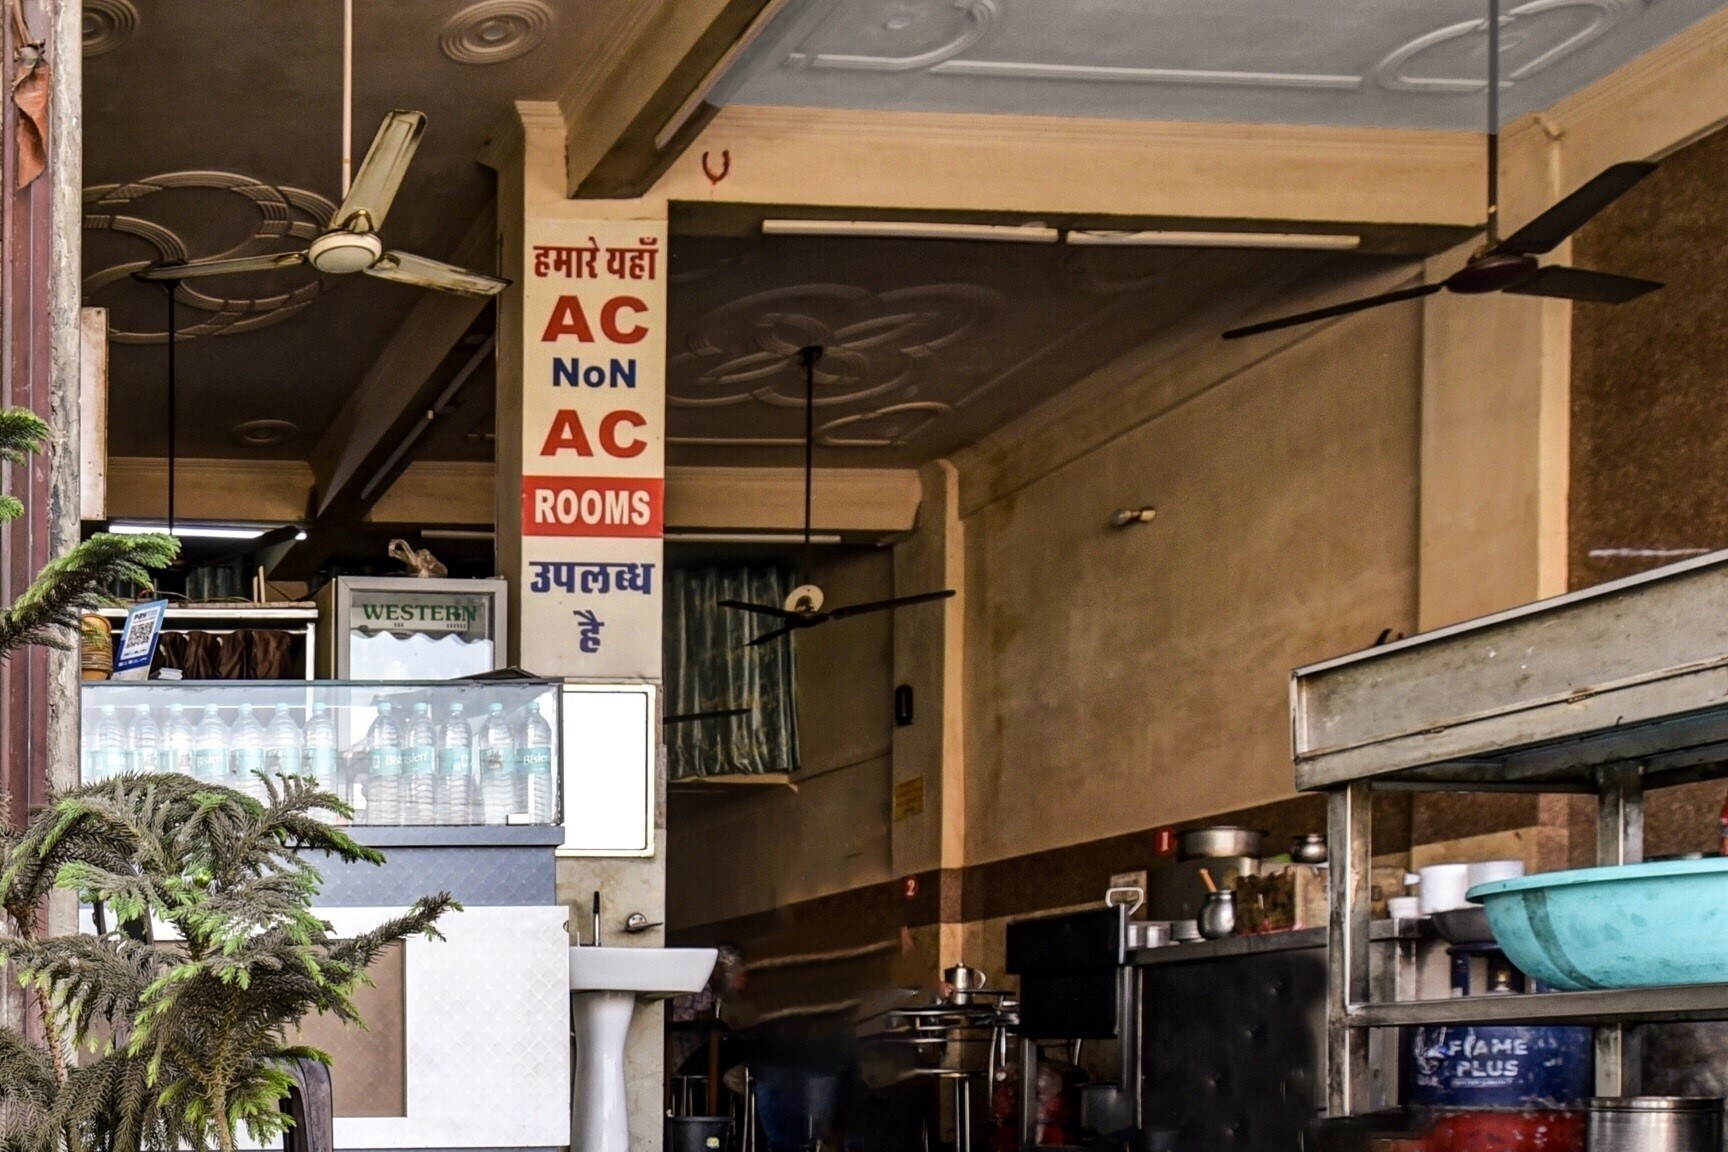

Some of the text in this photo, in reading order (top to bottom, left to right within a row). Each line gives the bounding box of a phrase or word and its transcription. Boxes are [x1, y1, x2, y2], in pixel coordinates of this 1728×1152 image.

[533, 236, 659, 280] हमारे यहाँ
[541, 295, 650, 345] AC
[540, 409, 648, 458] AC
[535, 488, 651, 526] ROOMS
[529, 560, 656, 595] उपलब्ध
[362, 603, 477, 622] WESTERN
[573, 610, 605, 654] है
[906, 879, 916, 896] 2
[1456, 1060, 1519, 1077] PLUS
